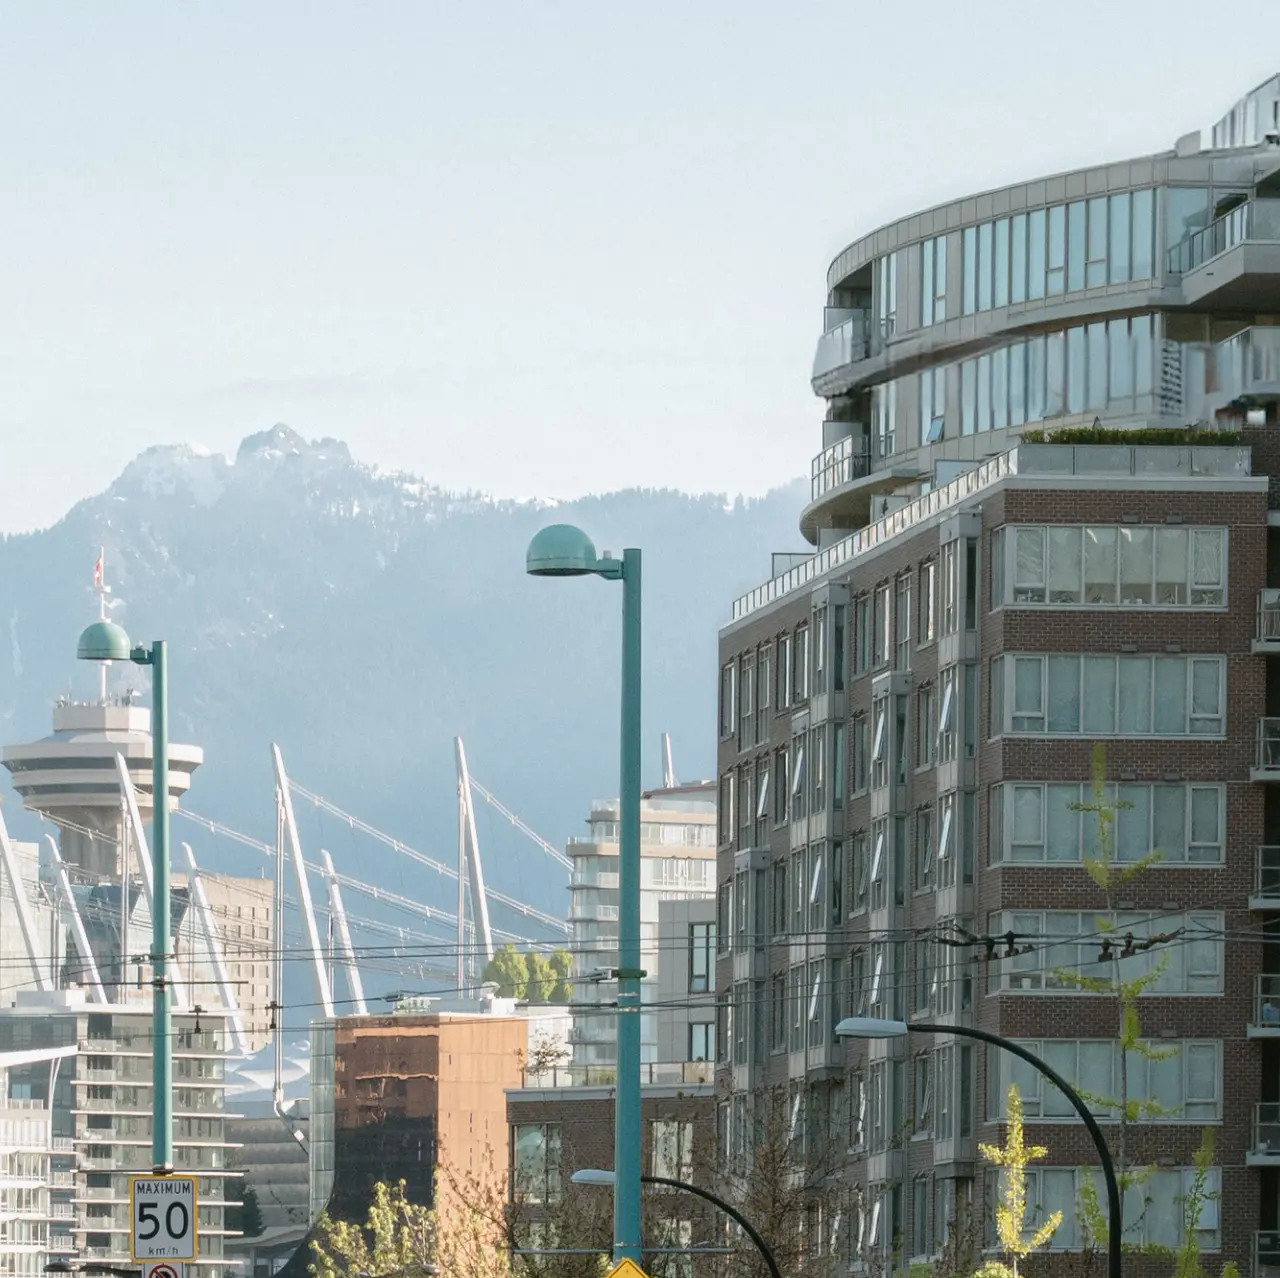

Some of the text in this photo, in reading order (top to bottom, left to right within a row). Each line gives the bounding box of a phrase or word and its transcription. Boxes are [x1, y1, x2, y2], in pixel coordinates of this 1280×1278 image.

[136, 1182, 191, 1194] MAXIMUM
[138, 1201, 189, 1240] 50
[148, 1246, 179, 1256] km/h
